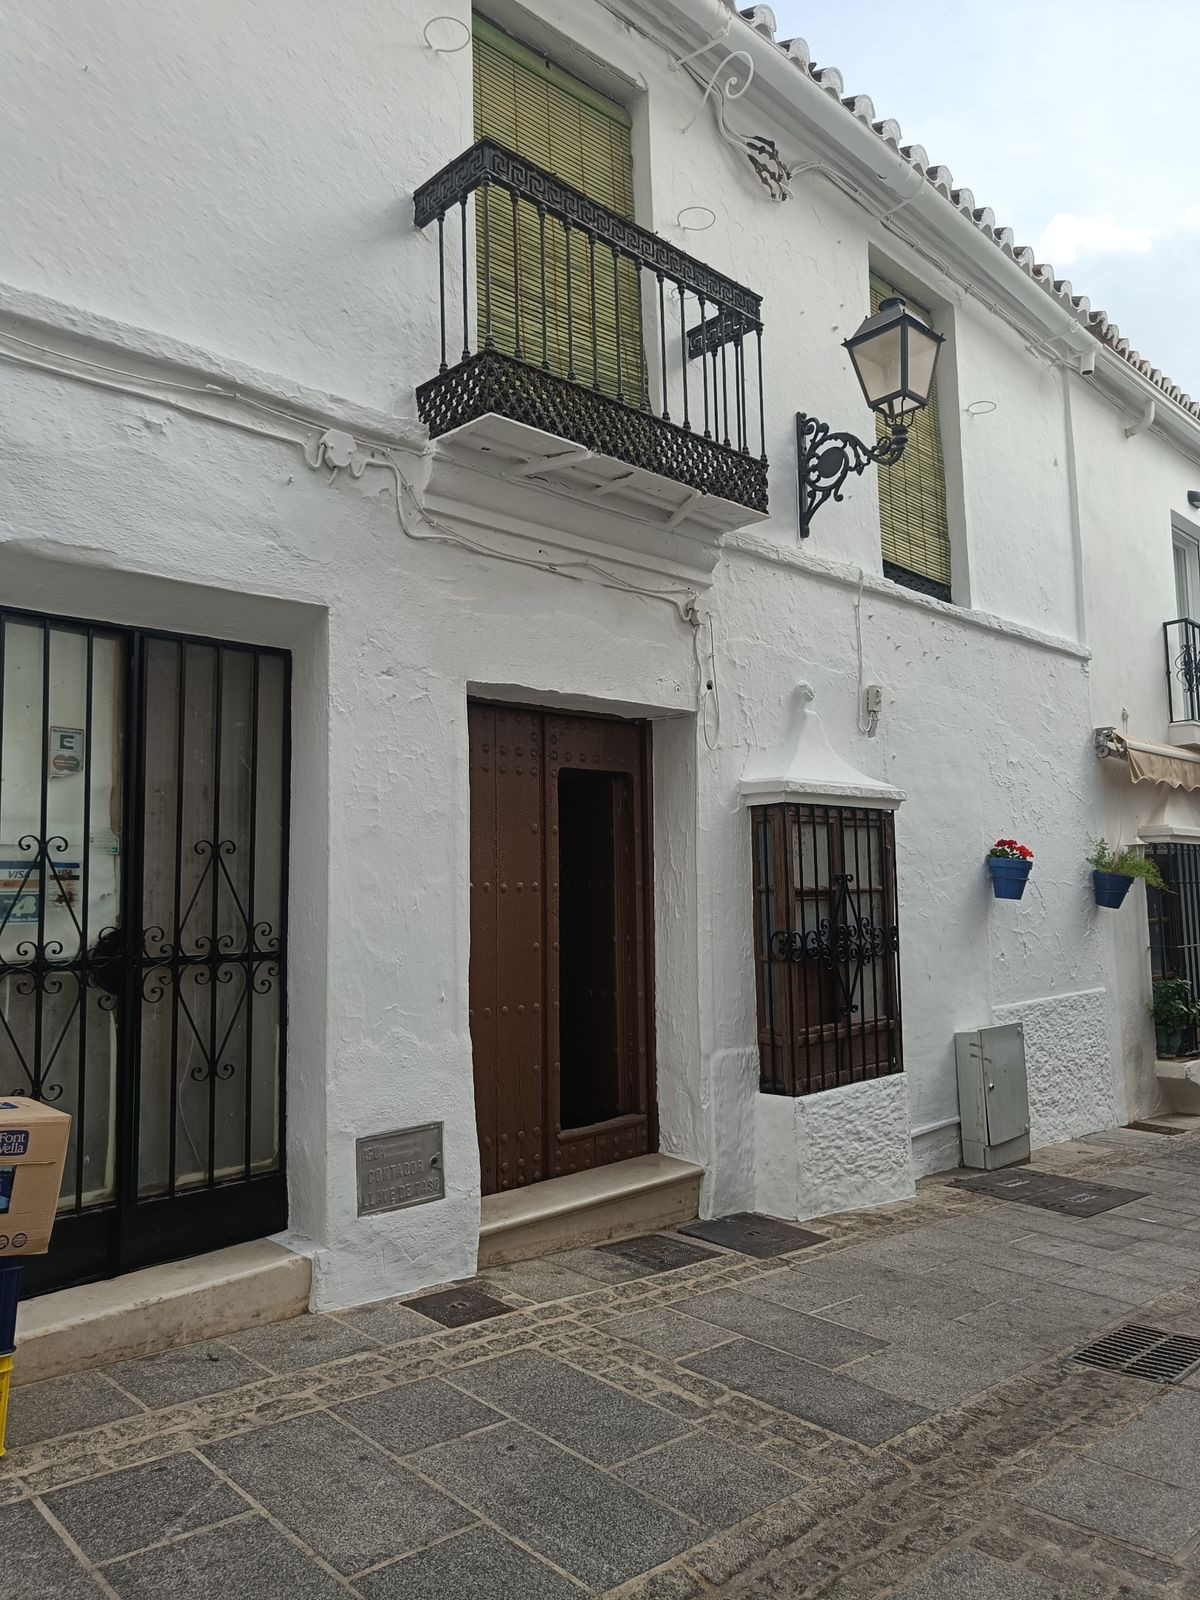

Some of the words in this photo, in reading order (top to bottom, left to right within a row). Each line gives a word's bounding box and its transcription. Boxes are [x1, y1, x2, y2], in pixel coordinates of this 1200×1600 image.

[8, 870, 30, 879] VIS
[0, 1132, 26, 1143] Font
[363, 1144, 385, 1161] AGUA
[367, 1160, 424, 1184] CONTADOR
[362, 1187, 396, 1207] LLAVE
[398, 1183, 412, 1201] DE
[415, 1176, 441, 1197] PASO
